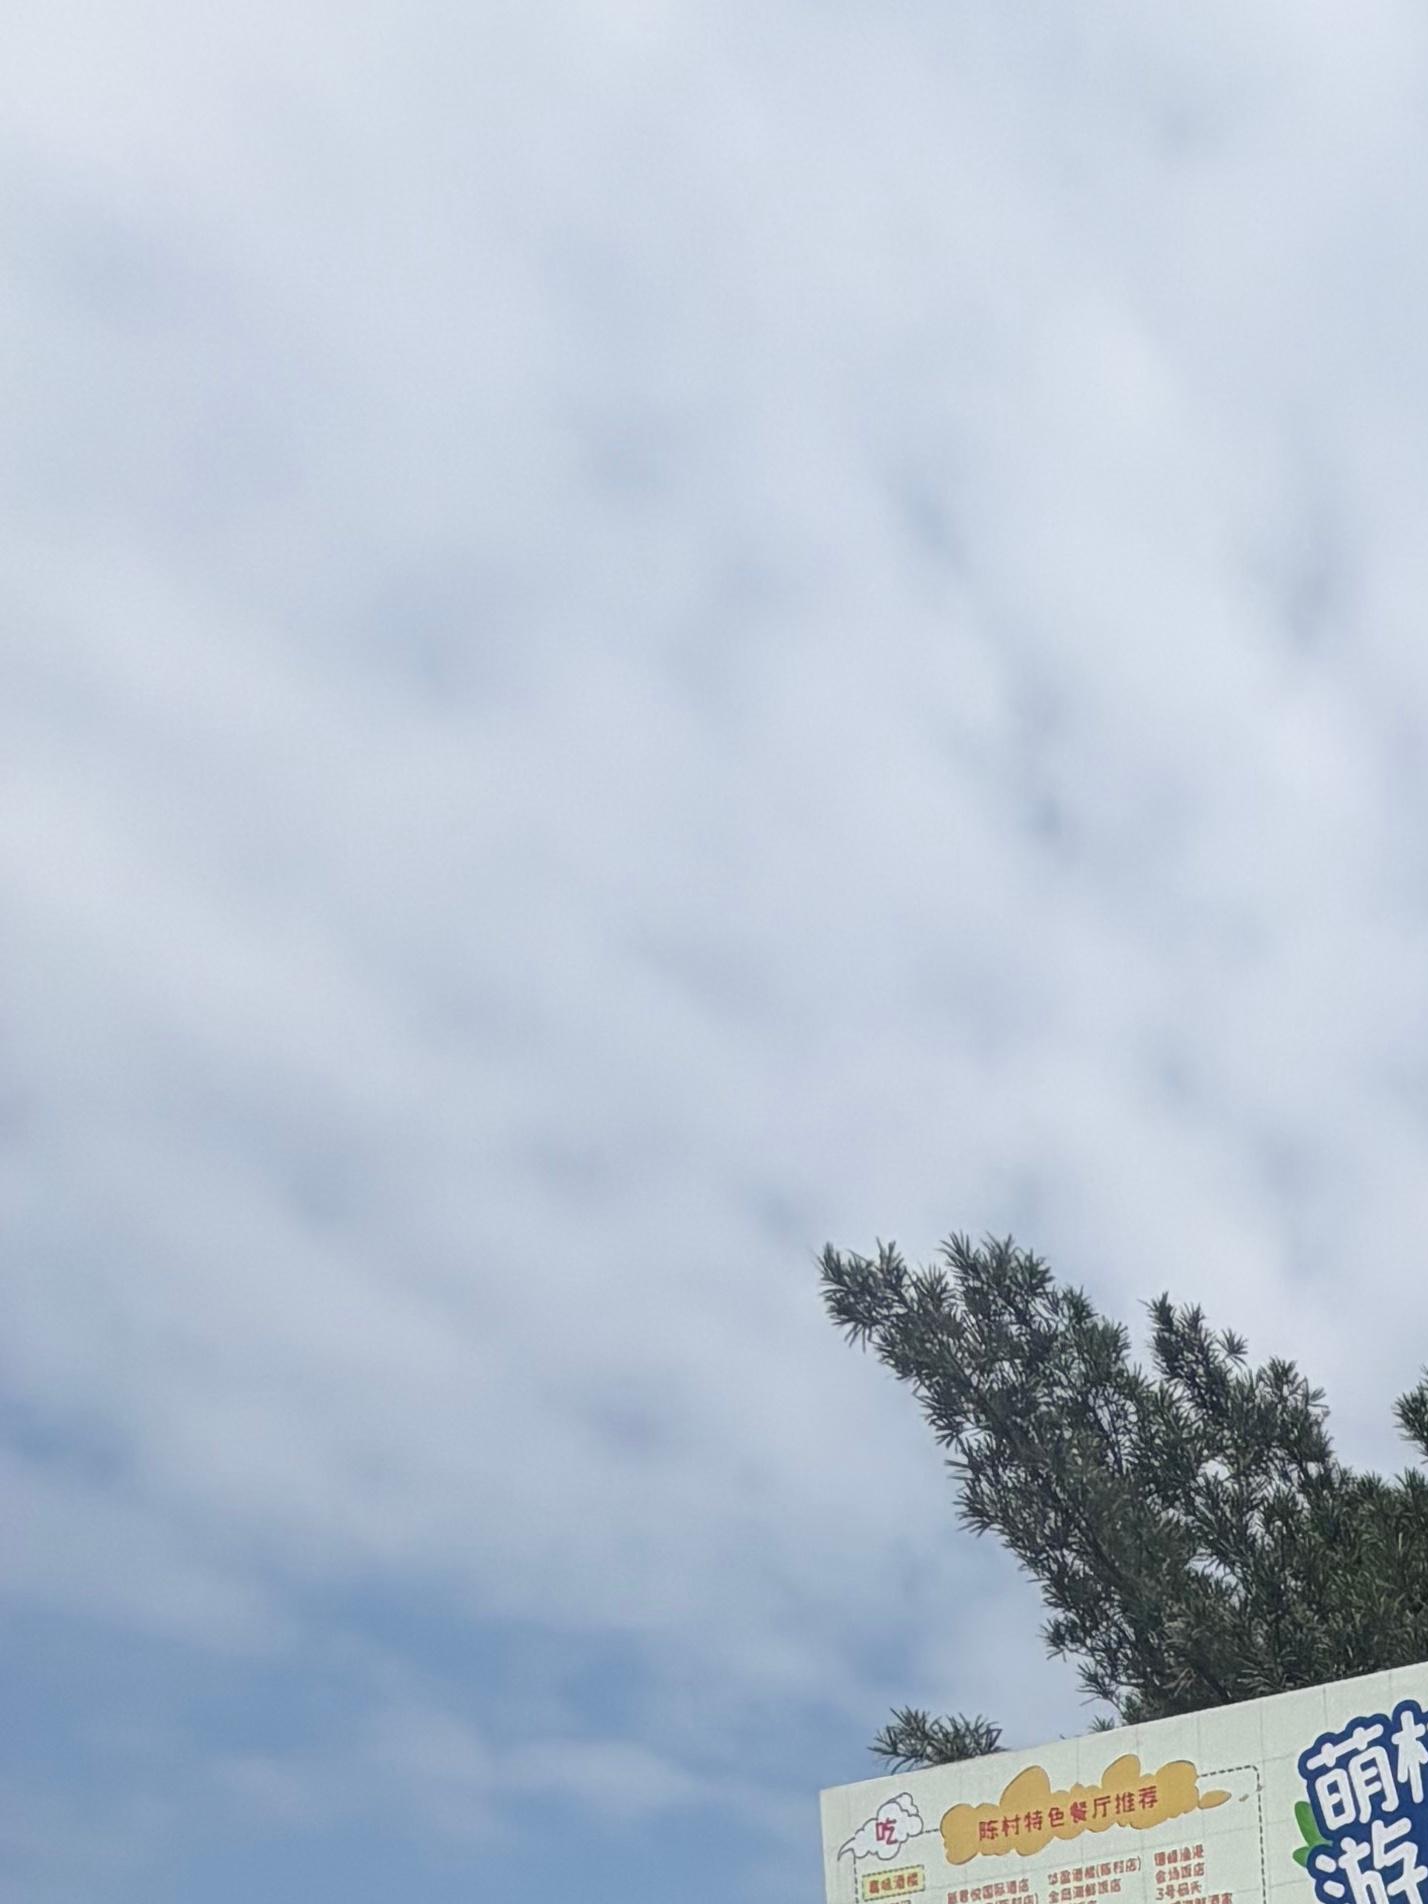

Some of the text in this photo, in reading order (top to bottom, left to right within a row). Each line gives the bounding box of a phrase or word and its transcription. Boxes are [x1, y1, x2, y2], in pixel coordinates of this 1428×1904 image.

[875, 1819, 898, 1846] 吃
[979, 1785, 1160, 1842] 陈村特色餐厅推荐
